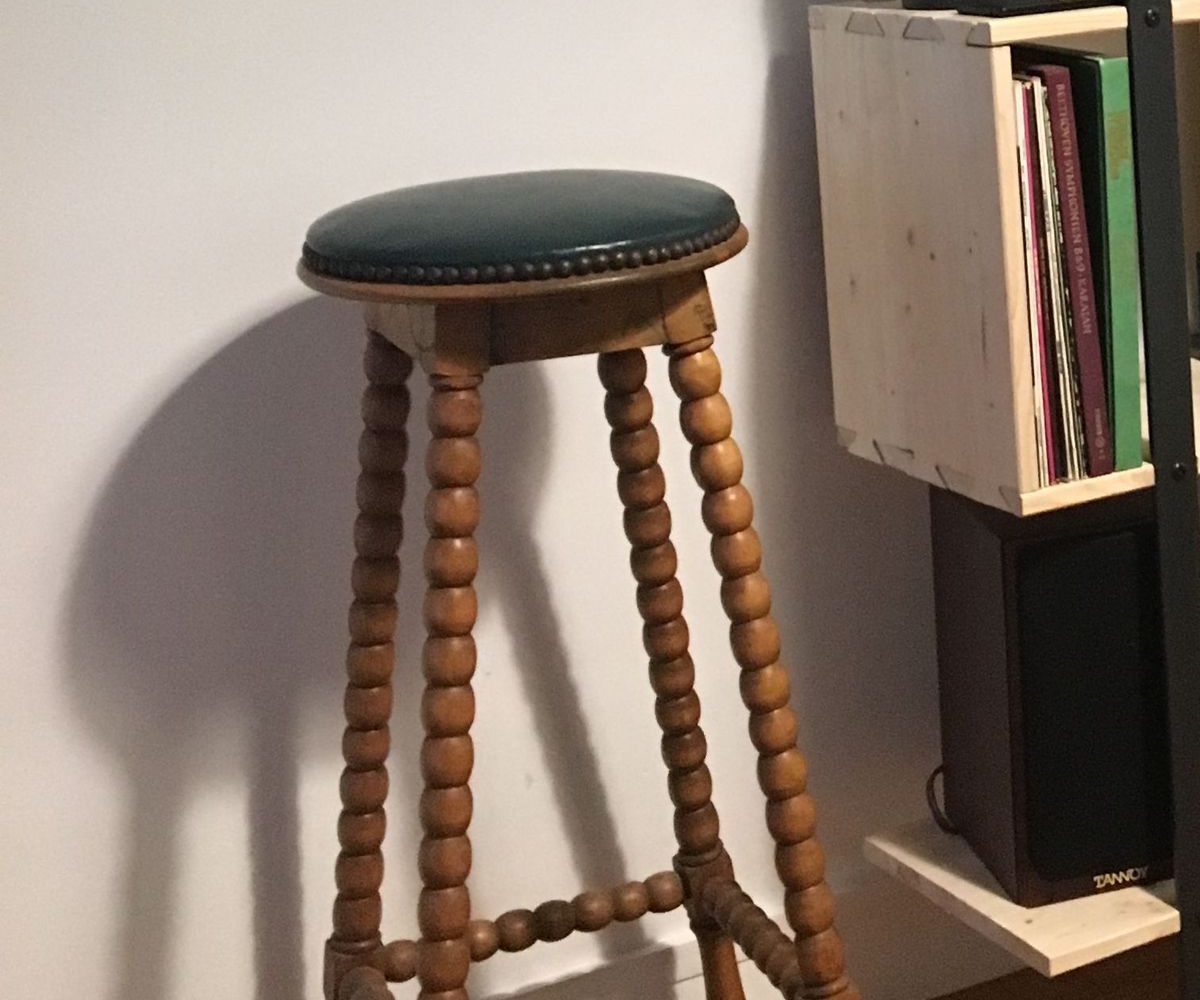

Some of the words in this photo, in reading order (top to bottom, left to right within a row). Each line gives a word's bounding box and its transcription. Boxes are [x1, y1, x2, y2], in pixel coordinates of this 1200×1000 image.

[1055, 83, 1073, 156] BEETHOVEN
[1063, 159, 1082, 244] SYMPHONIEN
[1093, 866, 1149, 889] TANNOY
